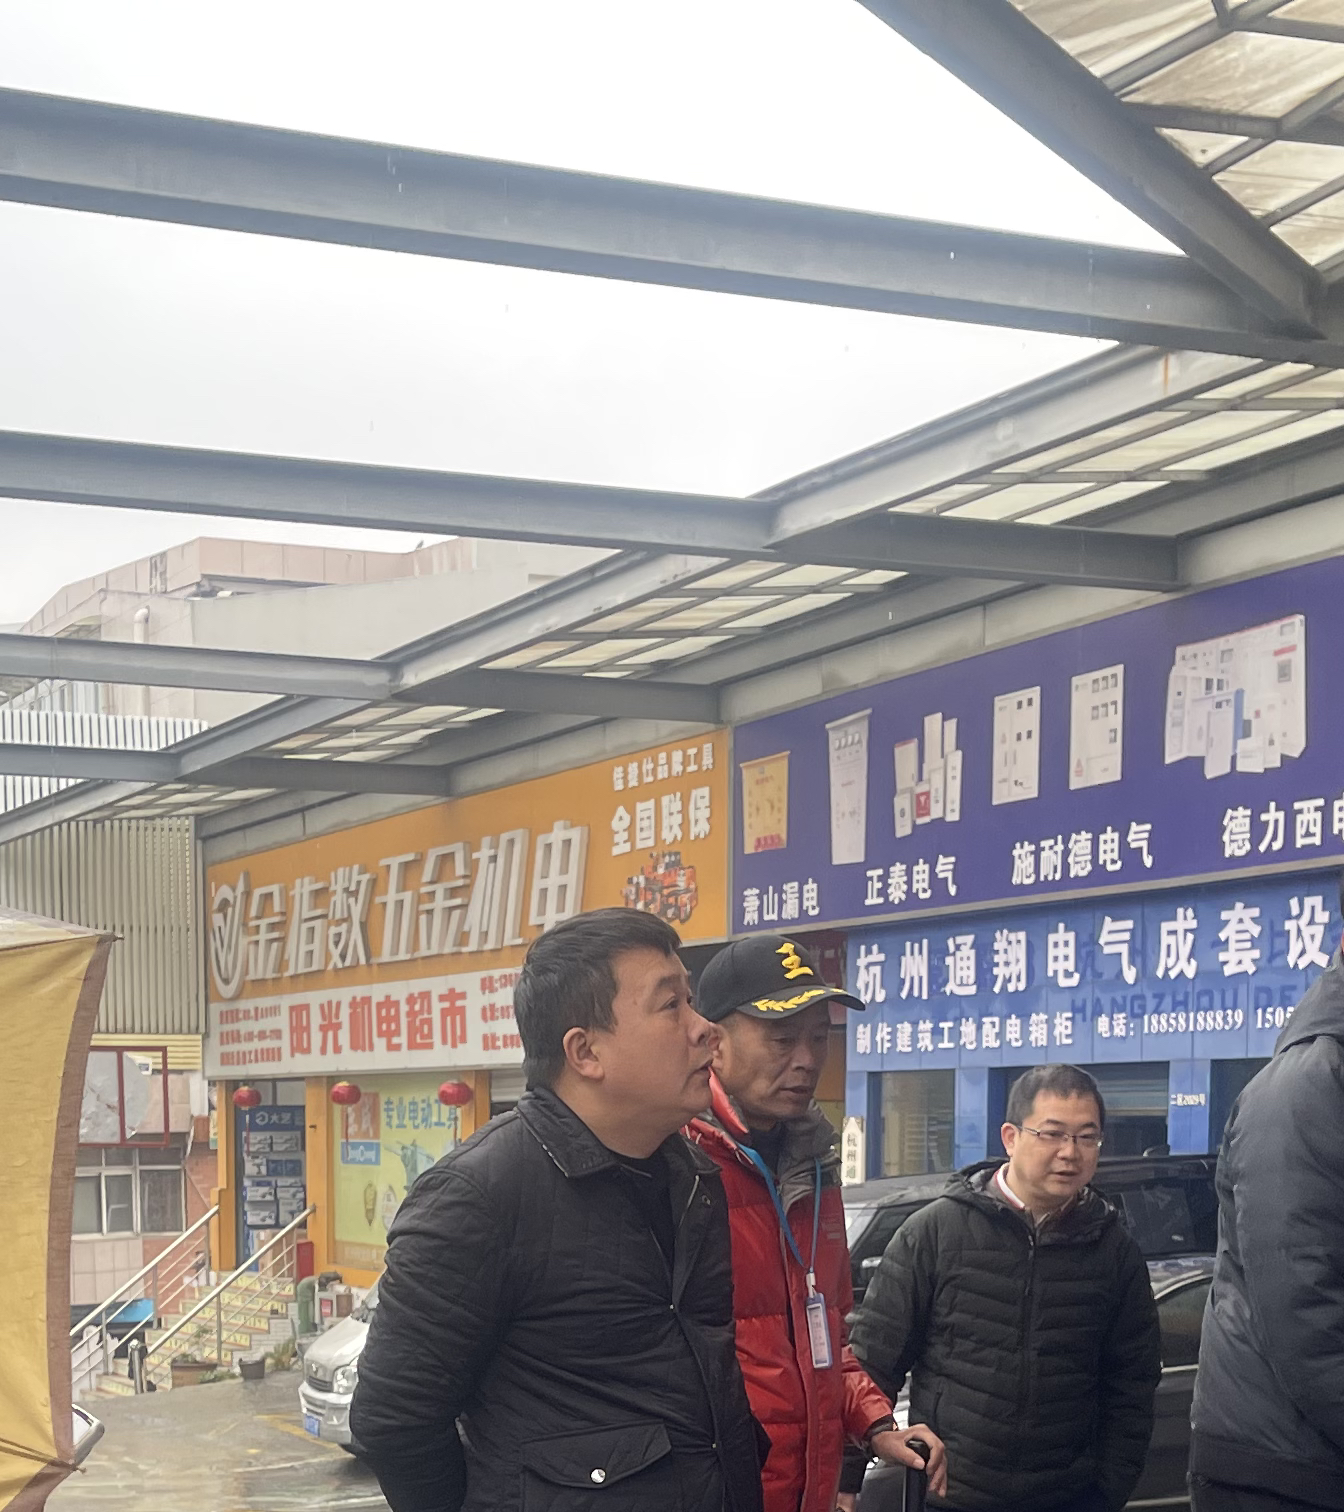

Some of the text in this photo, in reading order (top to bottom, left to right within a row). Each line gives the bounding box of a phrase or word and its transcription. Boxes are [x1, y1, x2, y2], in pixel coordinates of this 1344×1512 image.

[611, 786, 711, 857] 全国联保
[1011, 821, 1153, 886] 施耐德电气
[245, 820, 588, 981] 金指数五金机电
[743, 878, 820, 926] 萧山漏电
[865, 854, 957, 905] 正泰电气
[856, 895, 1330, 1004] 杭州通翔电气成套设
[288, 987, 468, 1058] 阳光机电超市
[857, 1012, 1073, 1054] 制作建筑工地配电箱柜
[383, 1096, 461, 1130] 专业电动工具
